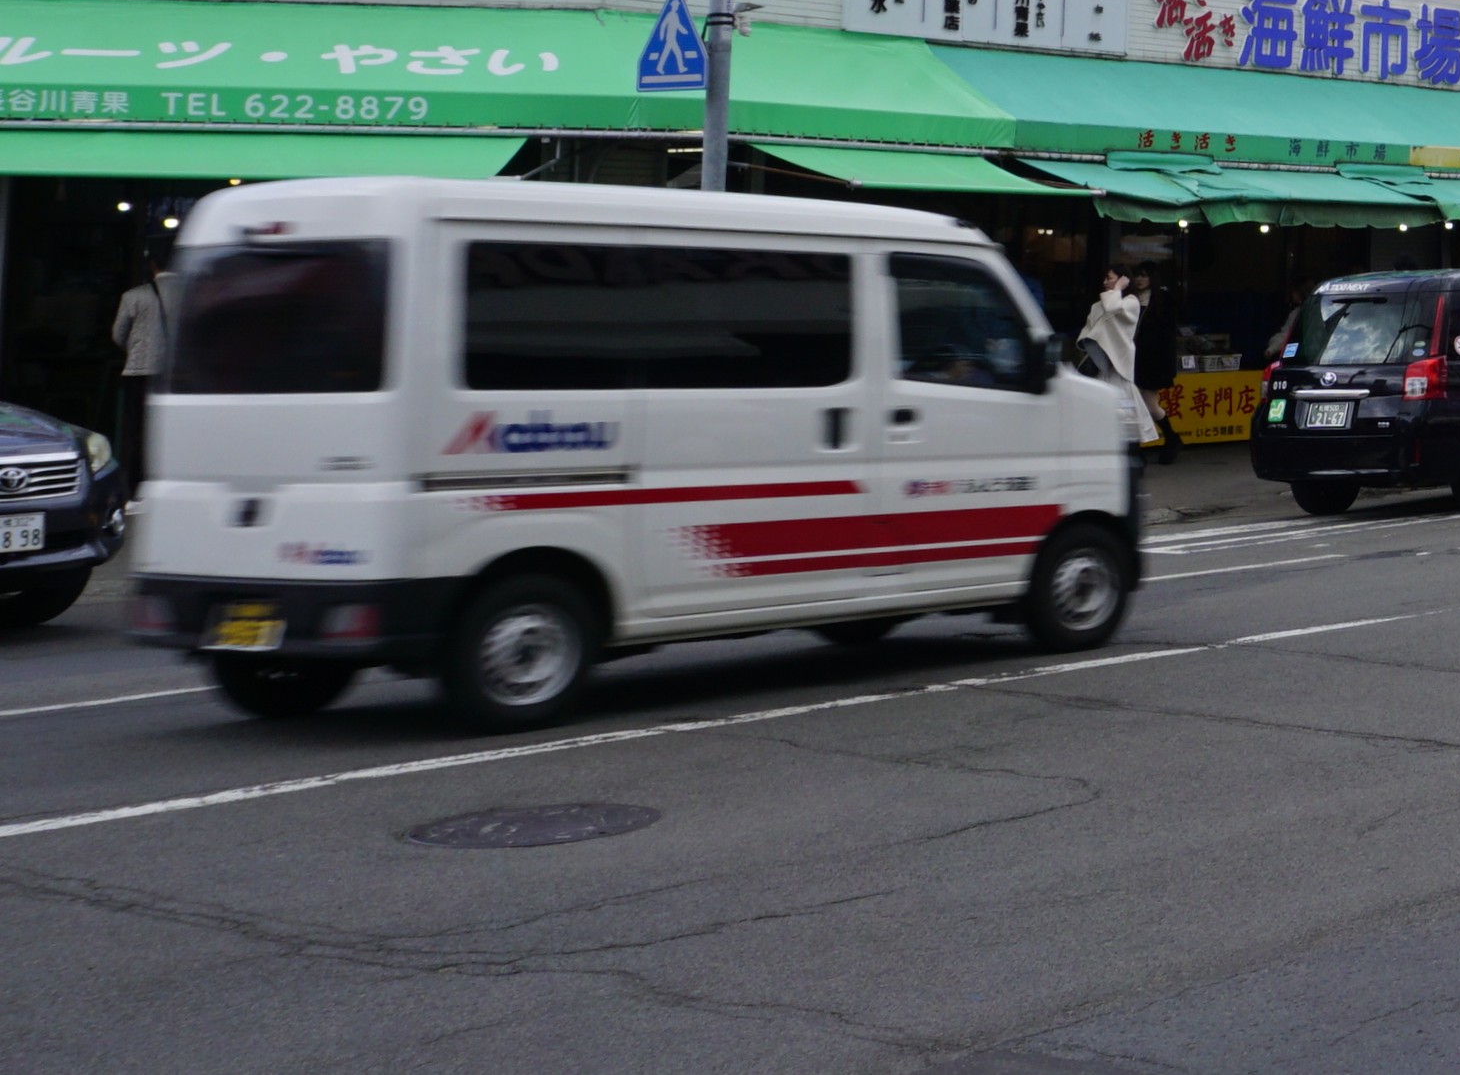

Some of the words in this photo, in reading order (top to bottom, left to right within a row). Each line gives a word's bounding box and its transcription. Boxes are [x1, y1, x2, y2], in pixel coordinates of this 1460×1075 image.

[0, 89, 130, 114] 谷川青果
[162, 92, 226, 116] TEL
[244, 93, 429, 121] 622-8879
[1288, 138, 1387, 162] 海鮮市場
[1273, 380, 1287, 390] 010
[1158, 384, 1256, 419] 蟹専門店
